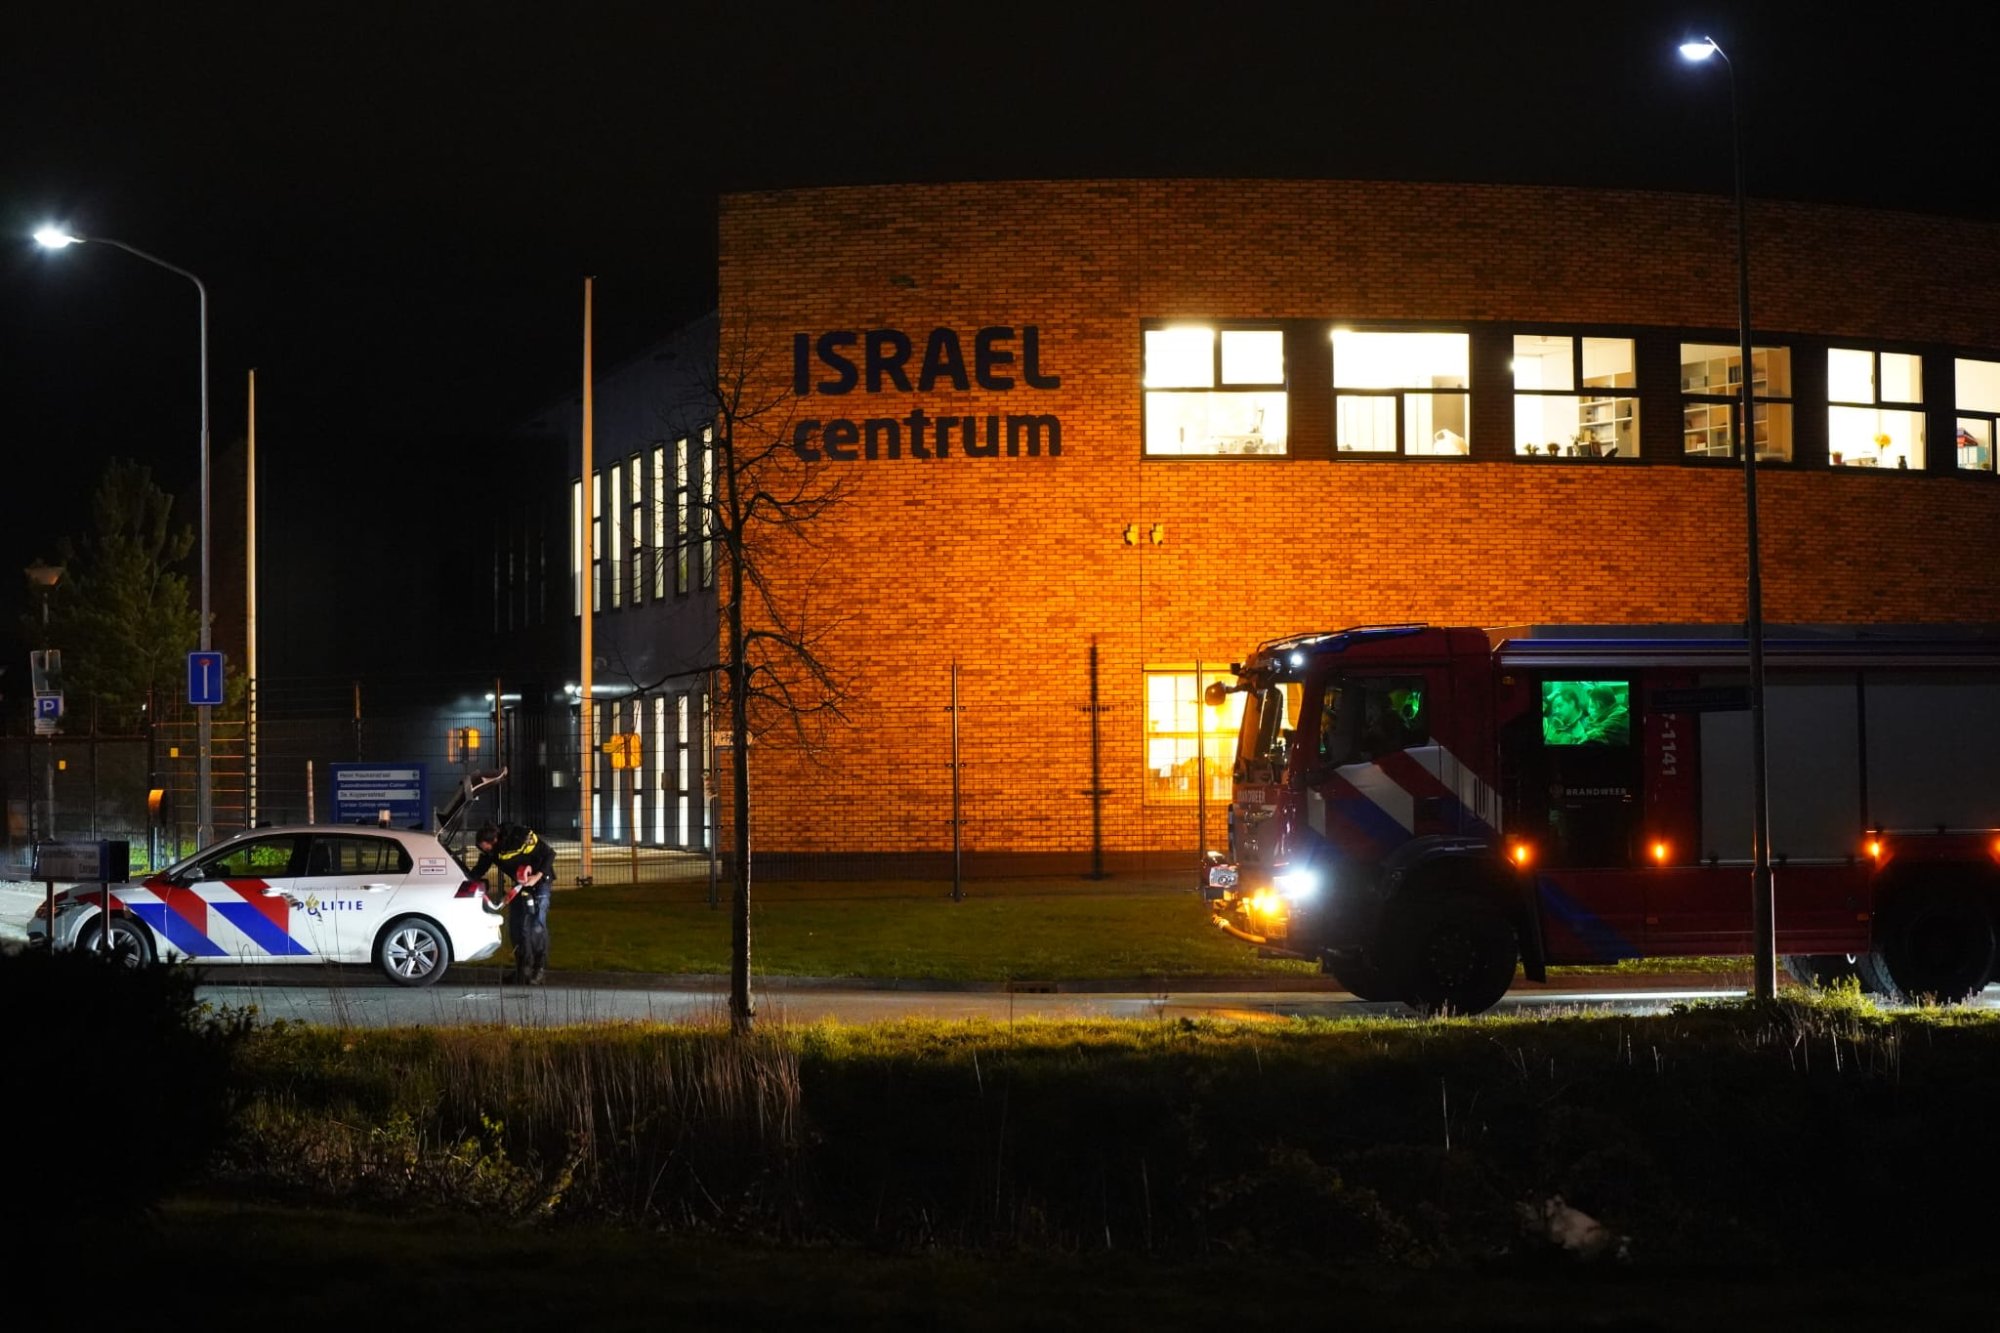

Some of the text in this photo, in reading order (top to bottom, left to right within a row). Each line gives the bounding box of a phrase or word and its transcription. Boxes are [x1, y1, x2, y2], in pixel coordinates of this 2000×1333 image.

[793, 326, 1061, 396] ISRAEL
[793, 408, 1062, 462] centrum
[297, 900, 363, 915] POLITIE
